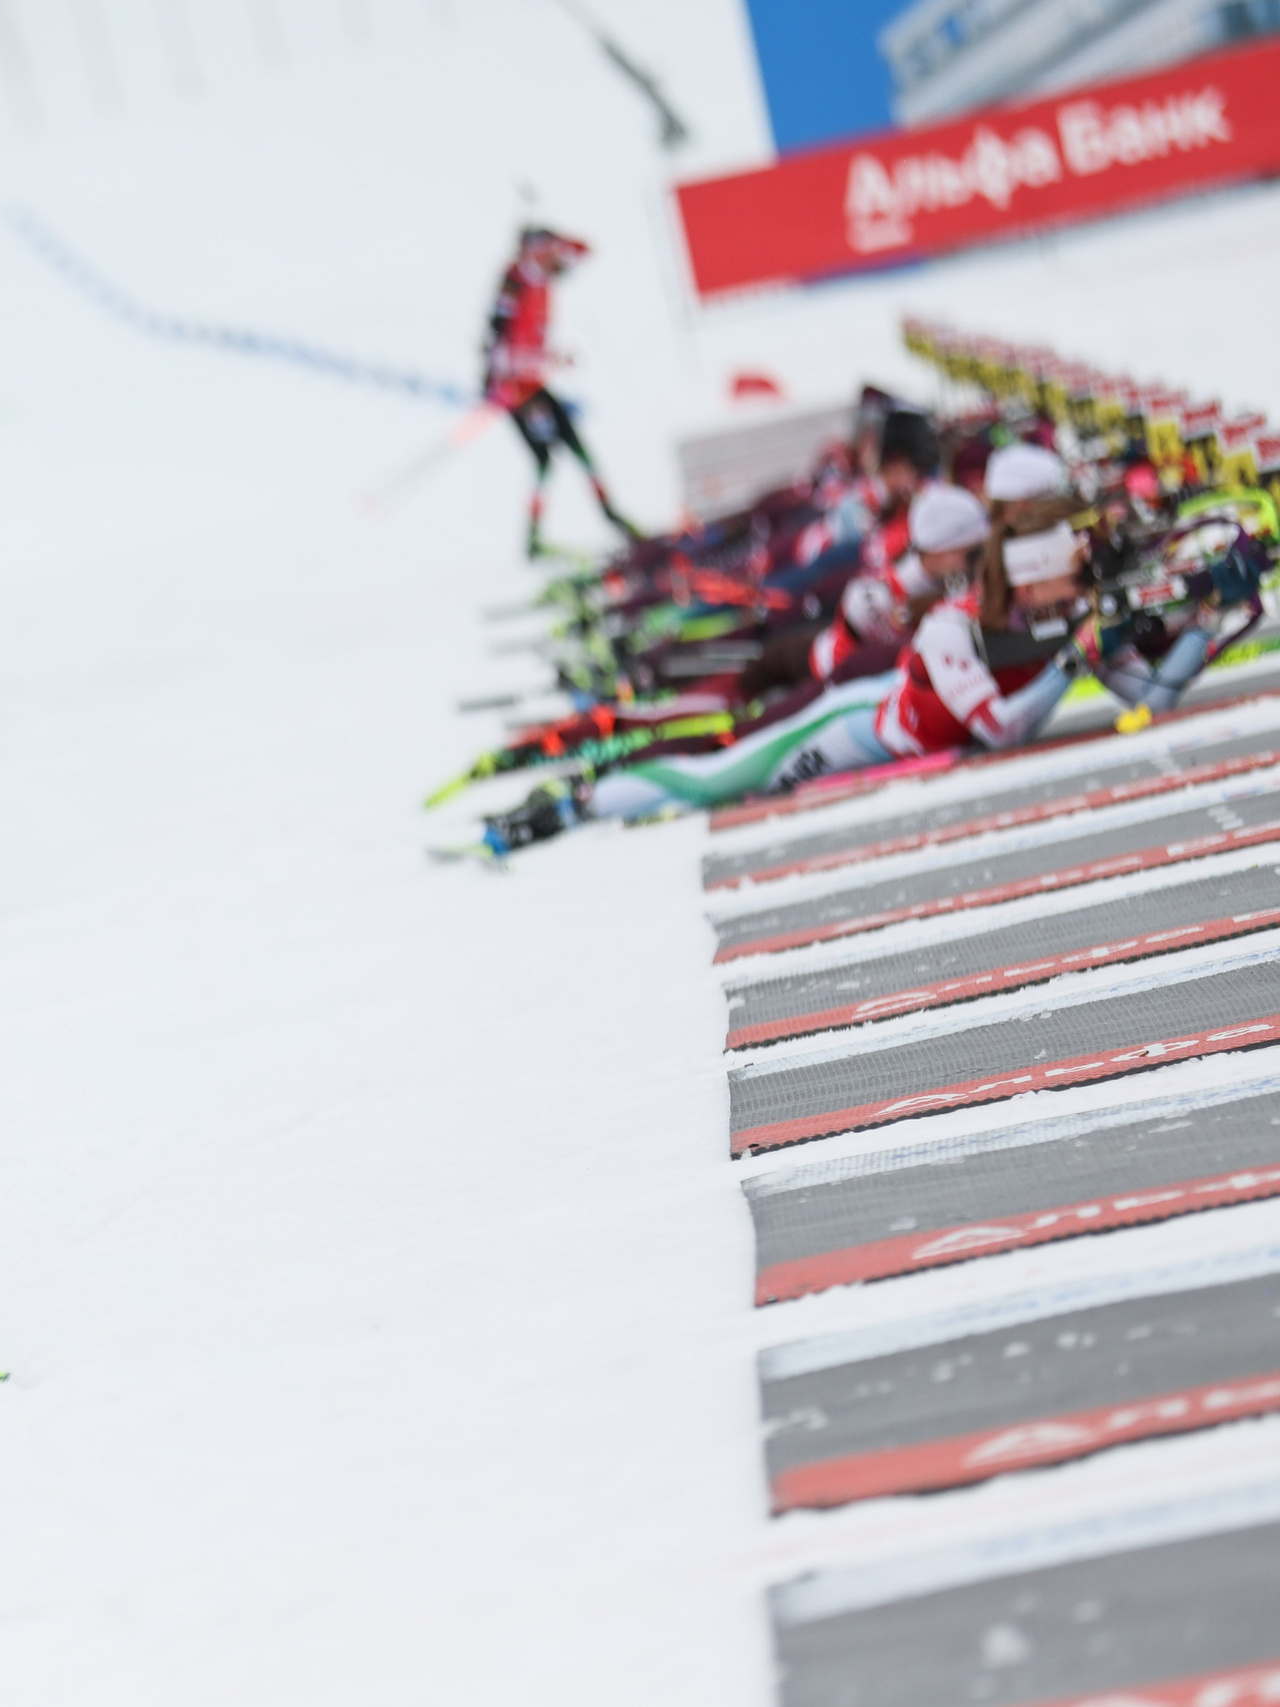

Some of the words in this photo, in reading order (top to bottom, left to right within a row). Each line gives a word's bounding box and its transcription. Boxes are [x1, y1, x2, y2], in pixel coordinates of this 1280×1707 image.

[845, 125, 1062, 252] Альфа
[1057, 85, 1231, 176] Банк
[871, 1023, 1276, 1118] Альфа
